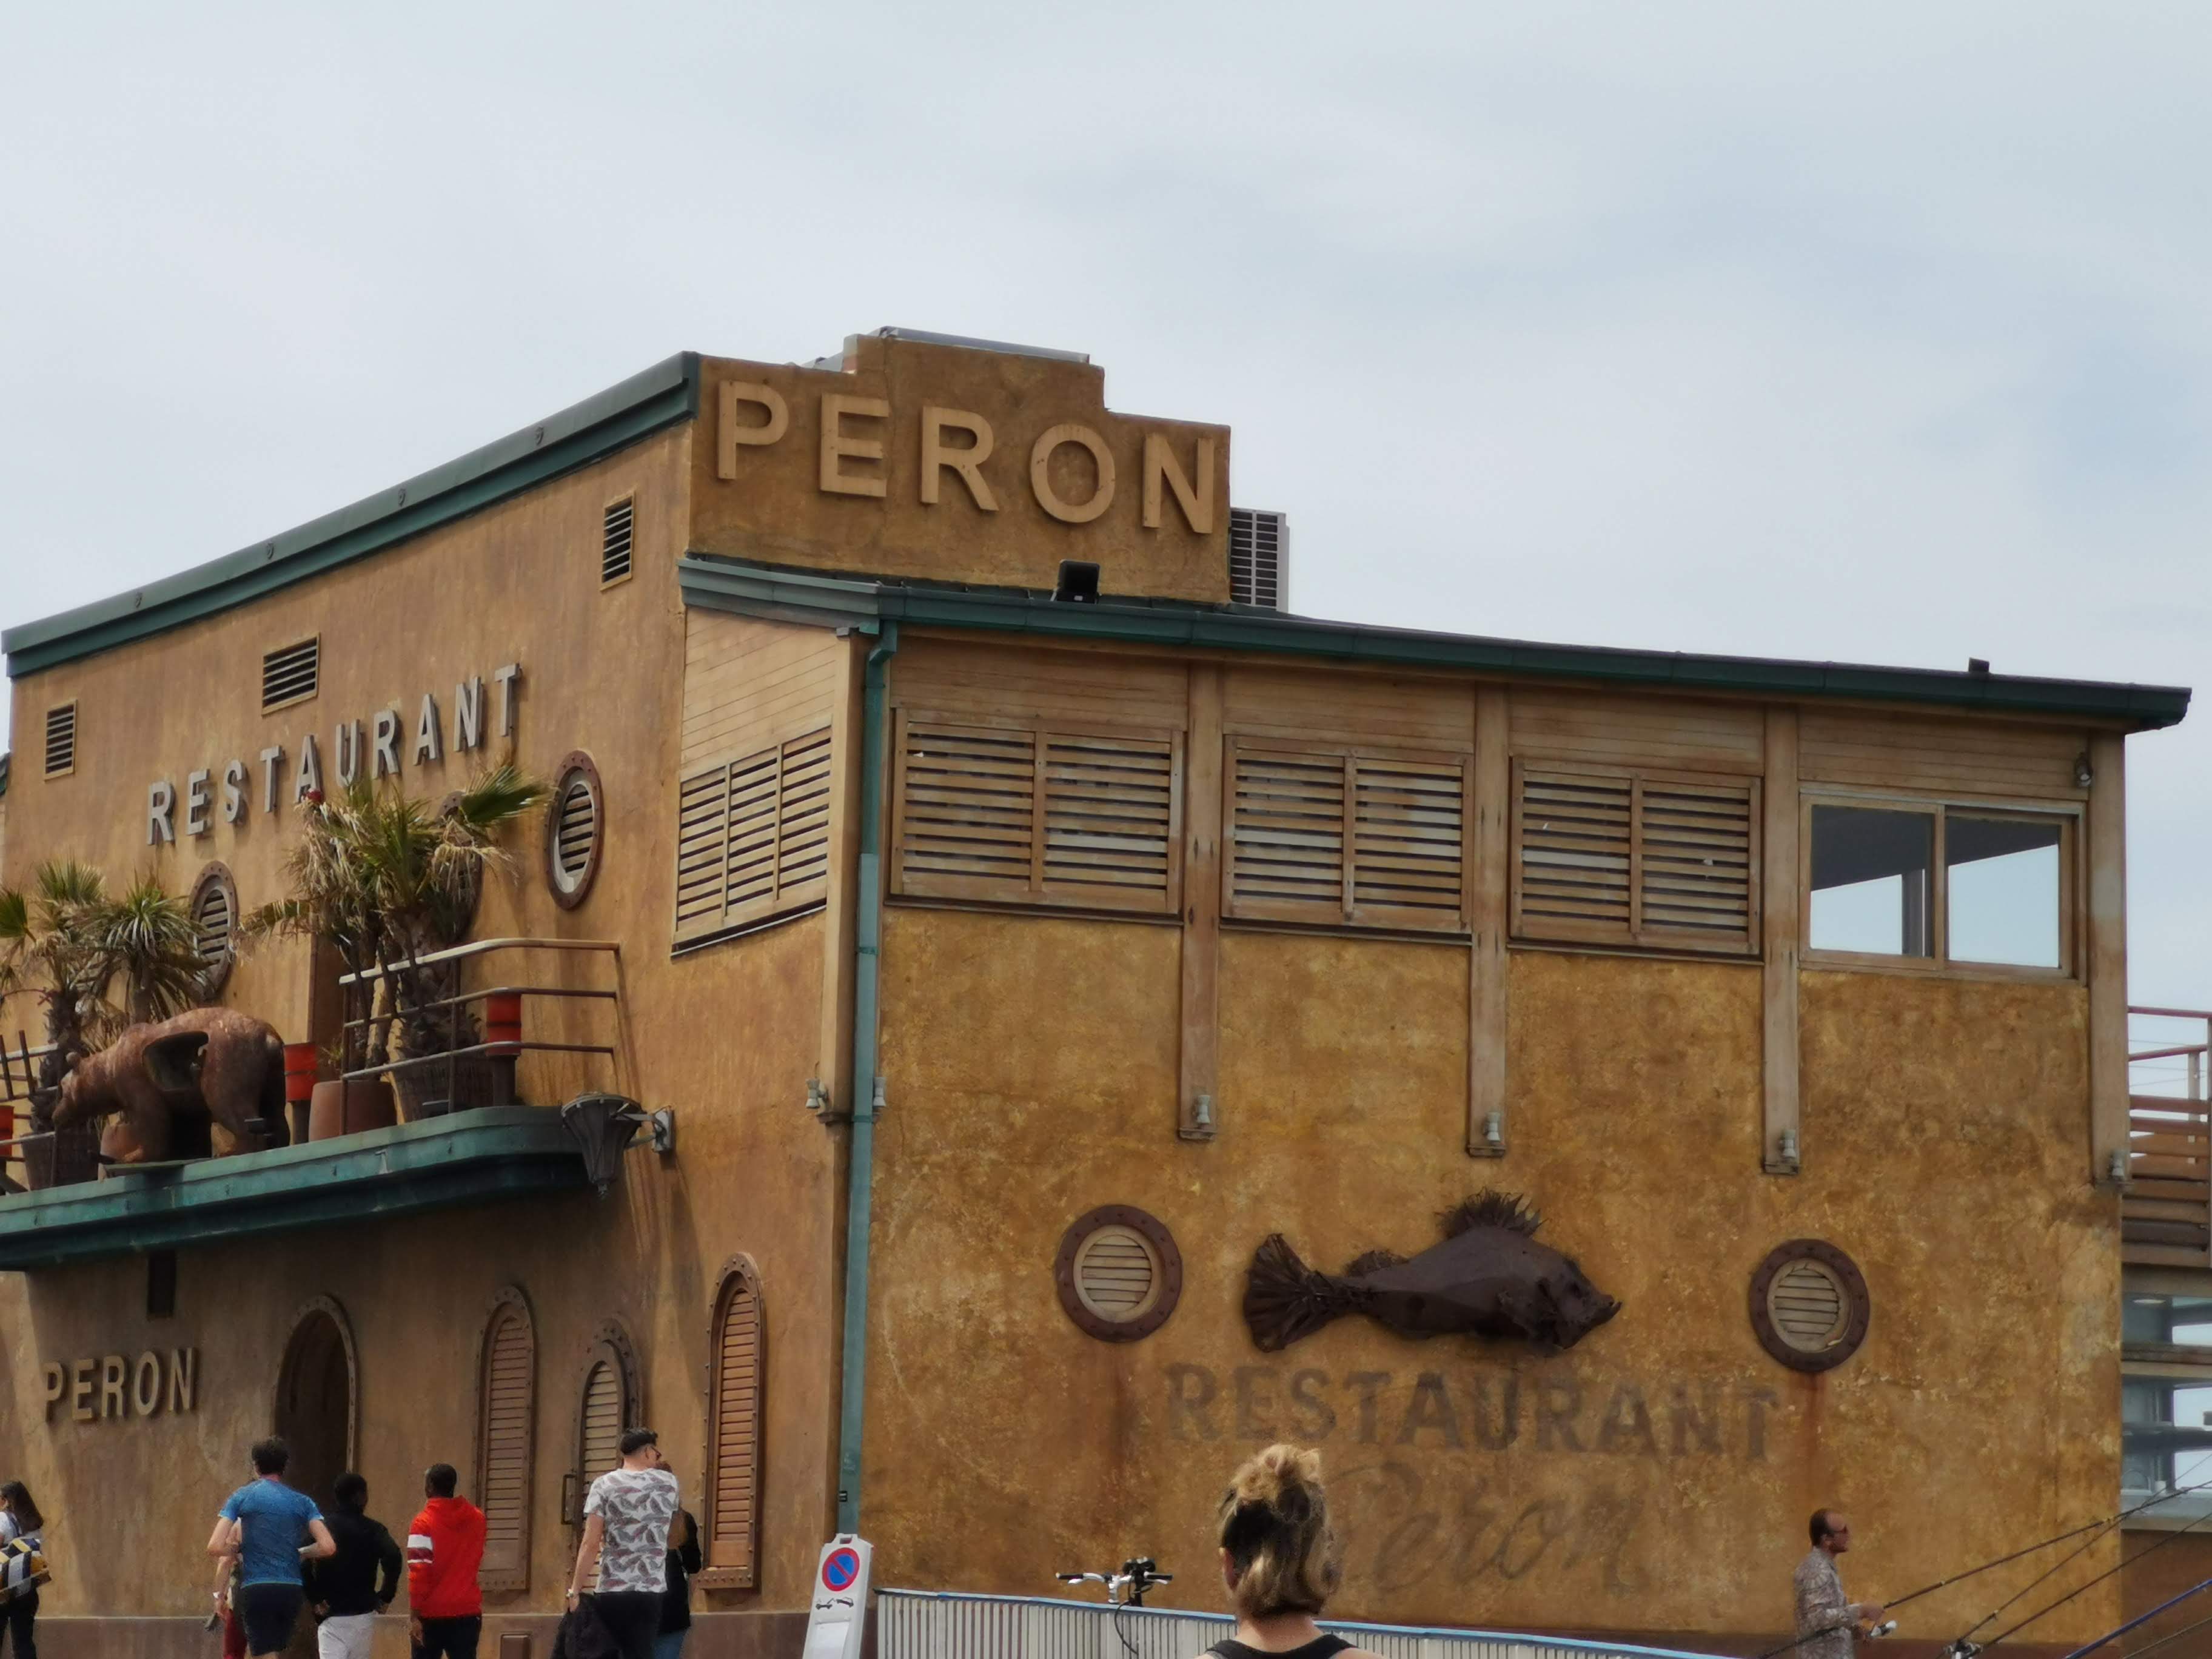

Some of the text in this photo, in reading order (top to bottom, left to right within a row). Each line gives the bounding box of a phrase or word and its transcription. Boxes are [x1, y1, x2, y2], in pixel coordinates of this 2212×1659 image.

[717, 380, 1213, 534] PERON
[146, 663, 521, 845] RESTAURANT
[44, 1347, 198, 1423] PERON
[1164, 1362, 1780, 1458] RESTAURANT
